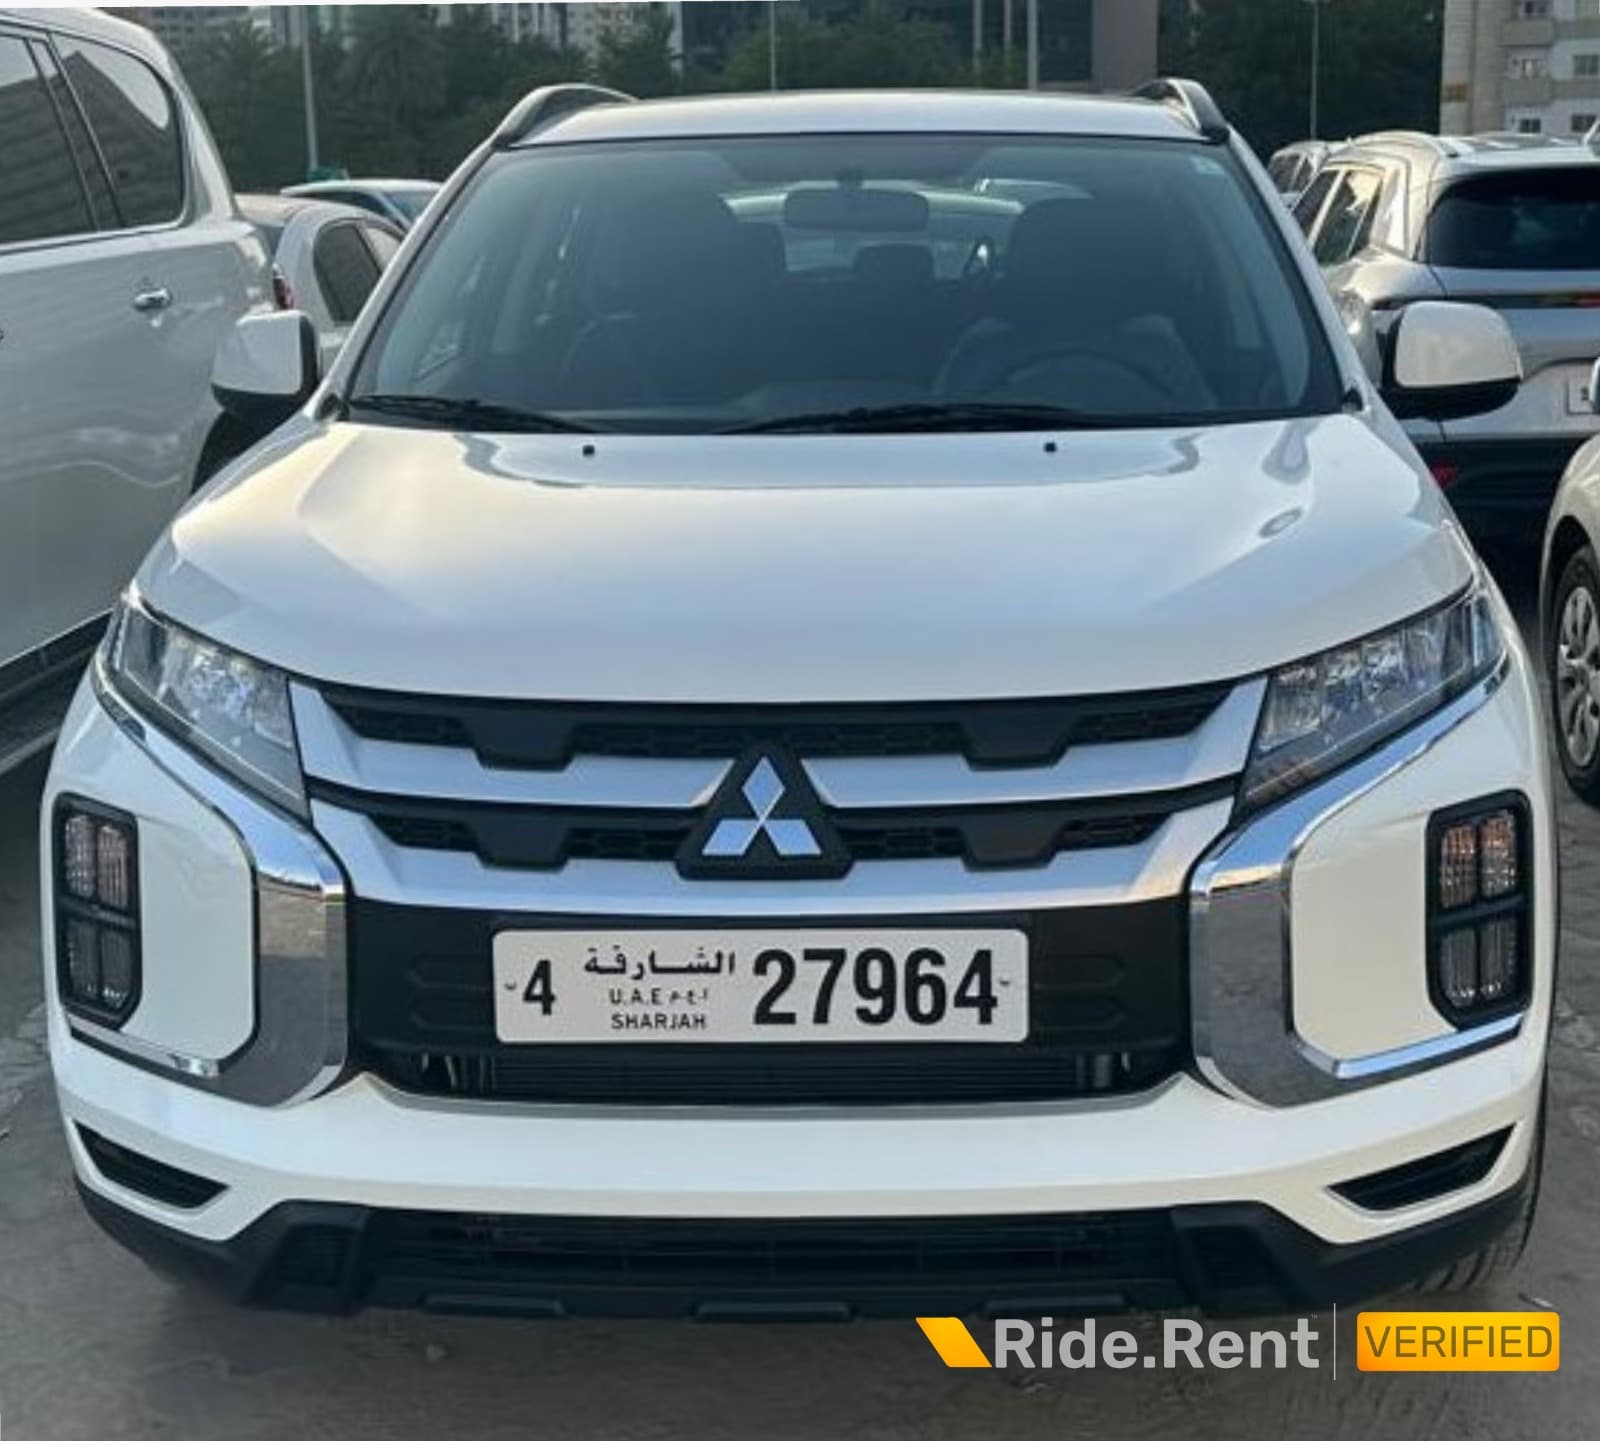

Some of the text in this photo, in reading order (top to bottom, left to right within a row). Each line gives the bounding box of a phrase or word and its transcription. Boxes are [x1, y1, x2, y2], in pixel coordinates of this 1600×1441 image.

[584, 944, 736, 981] الشارقة
[522, 959, 557, 1017] 4
[752, 947, 999, 1026] 27964
[610, 1012, 707, 1031] SHARJAH
